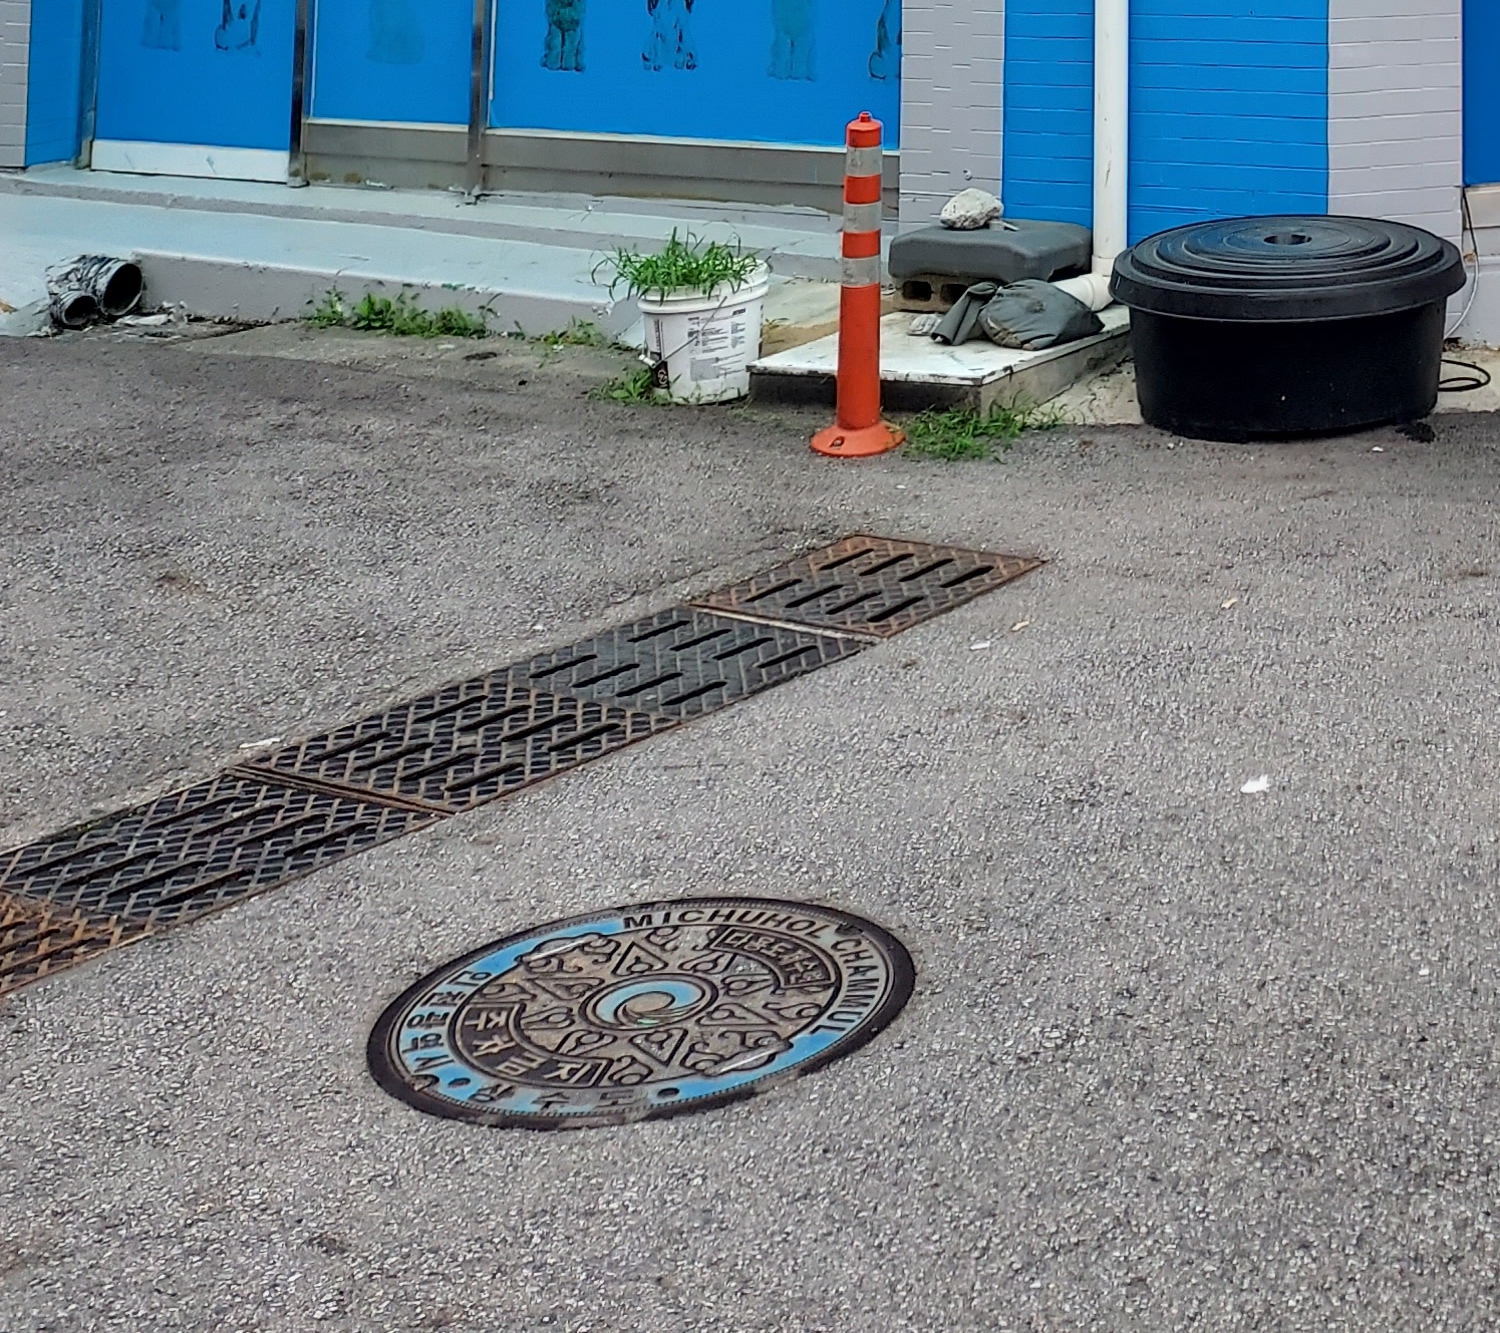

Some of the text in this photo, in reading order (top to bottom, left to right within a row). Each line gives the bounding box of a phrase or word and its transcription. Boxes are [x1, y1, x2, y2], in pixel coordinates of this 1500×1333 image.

[401, 969, 493, 1075] 인천광역시
[623, 907, 886, 1037] MICHUHOL CHAMMUL
[459, 1002, 603, 1087] 주차금지
